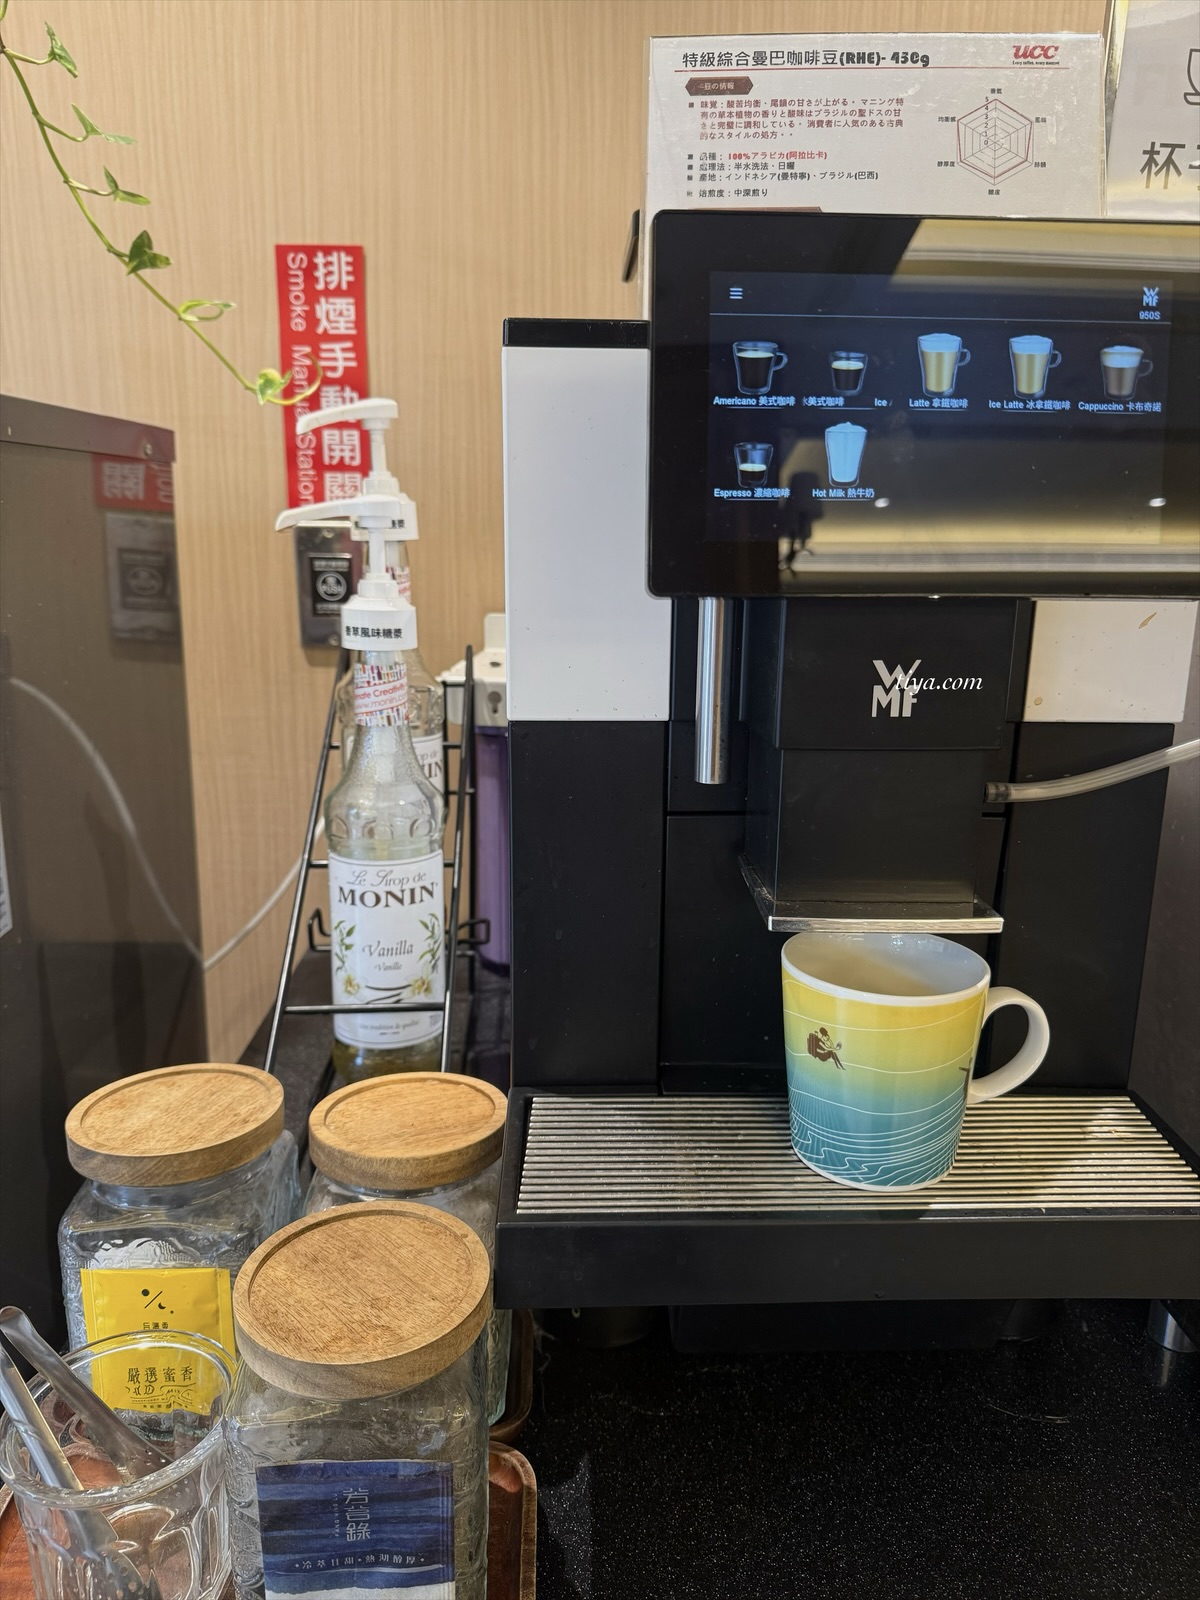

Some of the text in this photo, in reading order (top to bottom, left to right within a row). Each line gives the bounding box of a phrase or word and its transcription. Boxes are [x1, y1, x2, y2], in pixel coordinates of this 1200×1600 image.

[286, 251, 309, 332] Smoke
[1139, 311, 1161, 321] 950S
[713, 396, 796, 407] Americano 美式咖啡
[909, 397, 969, 409] Latte 拿鐵咖啡
[988, 399, 1071, 411] Ice Latte 冰拿鐵咖啡
[1078, 401, 1162, 412] Cappuccino 卡布奇諾
[713, 488, 752, 499] Espresso
[812, 487, 875, 499] Hot Milk 熱牛奶
[347, 869, 427, 889] Le Sirop de
[338, 882, 435, 909] MONIN
[362, 940, 414, 957] Vanilla
[127, 1365, 193, 1385] 嚴選蜜香
